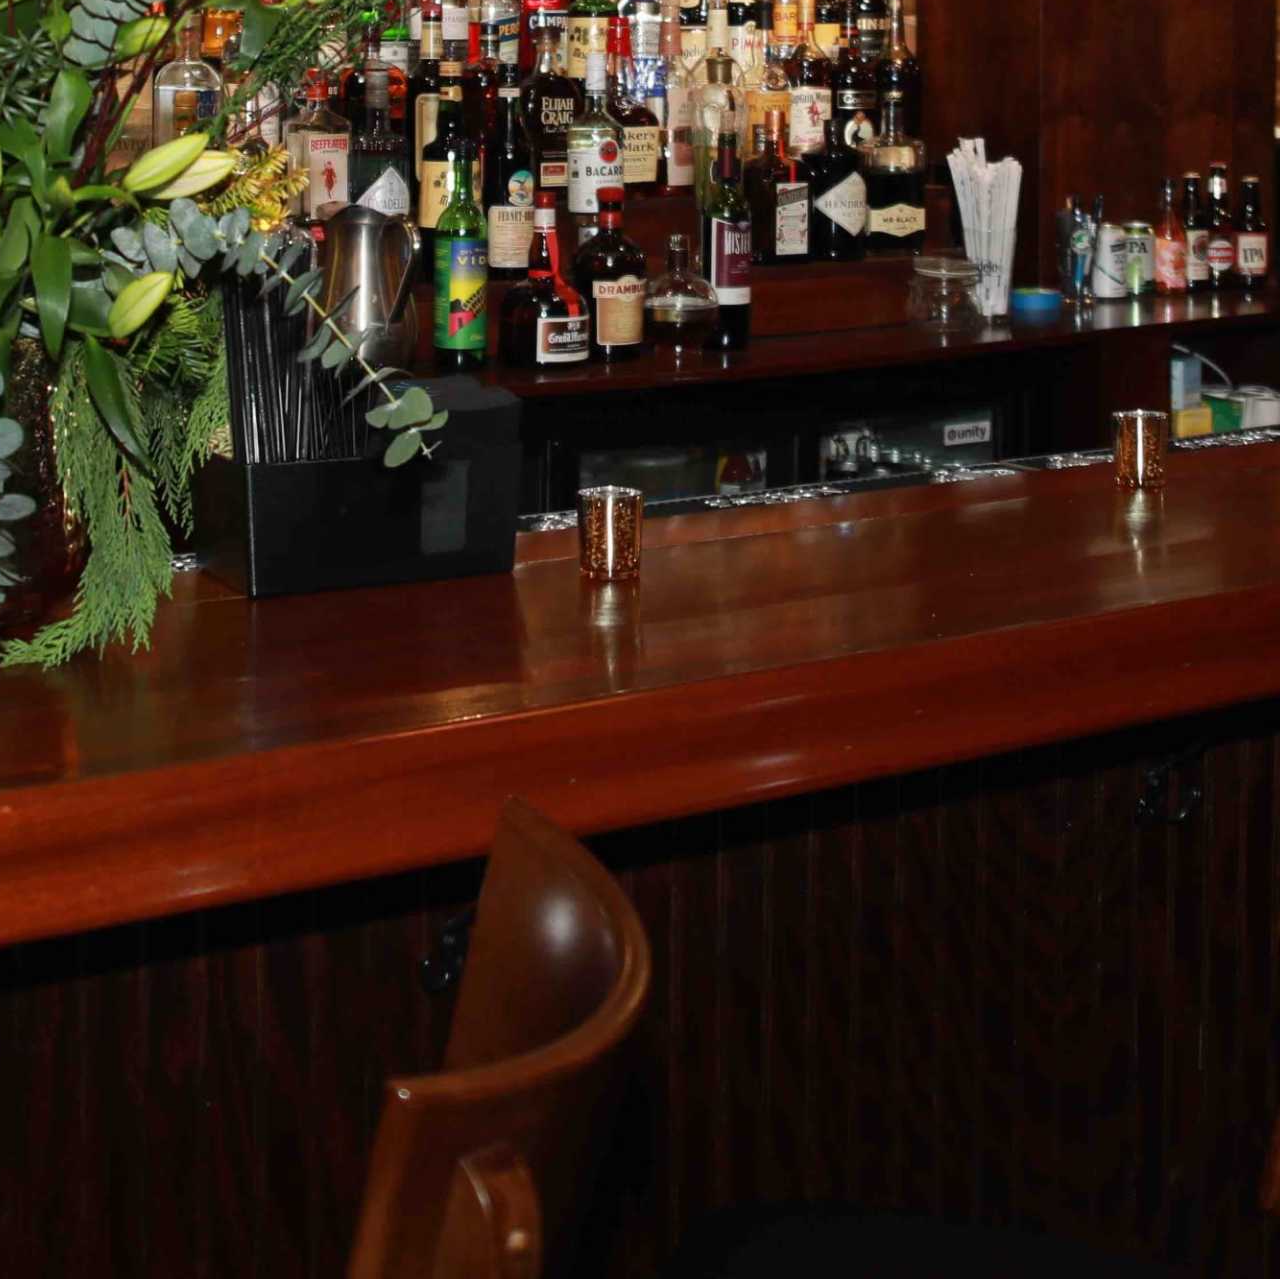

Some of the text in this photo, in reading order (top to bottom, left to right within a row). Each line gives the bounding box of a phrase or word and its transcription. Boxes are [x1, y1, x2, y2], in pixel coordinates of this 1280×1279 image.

[541, 96, 574, 111] ELIJAH
[541, 110, 574, 126] CRAIG
[310, 138, 348, 152] BEEFEATER
